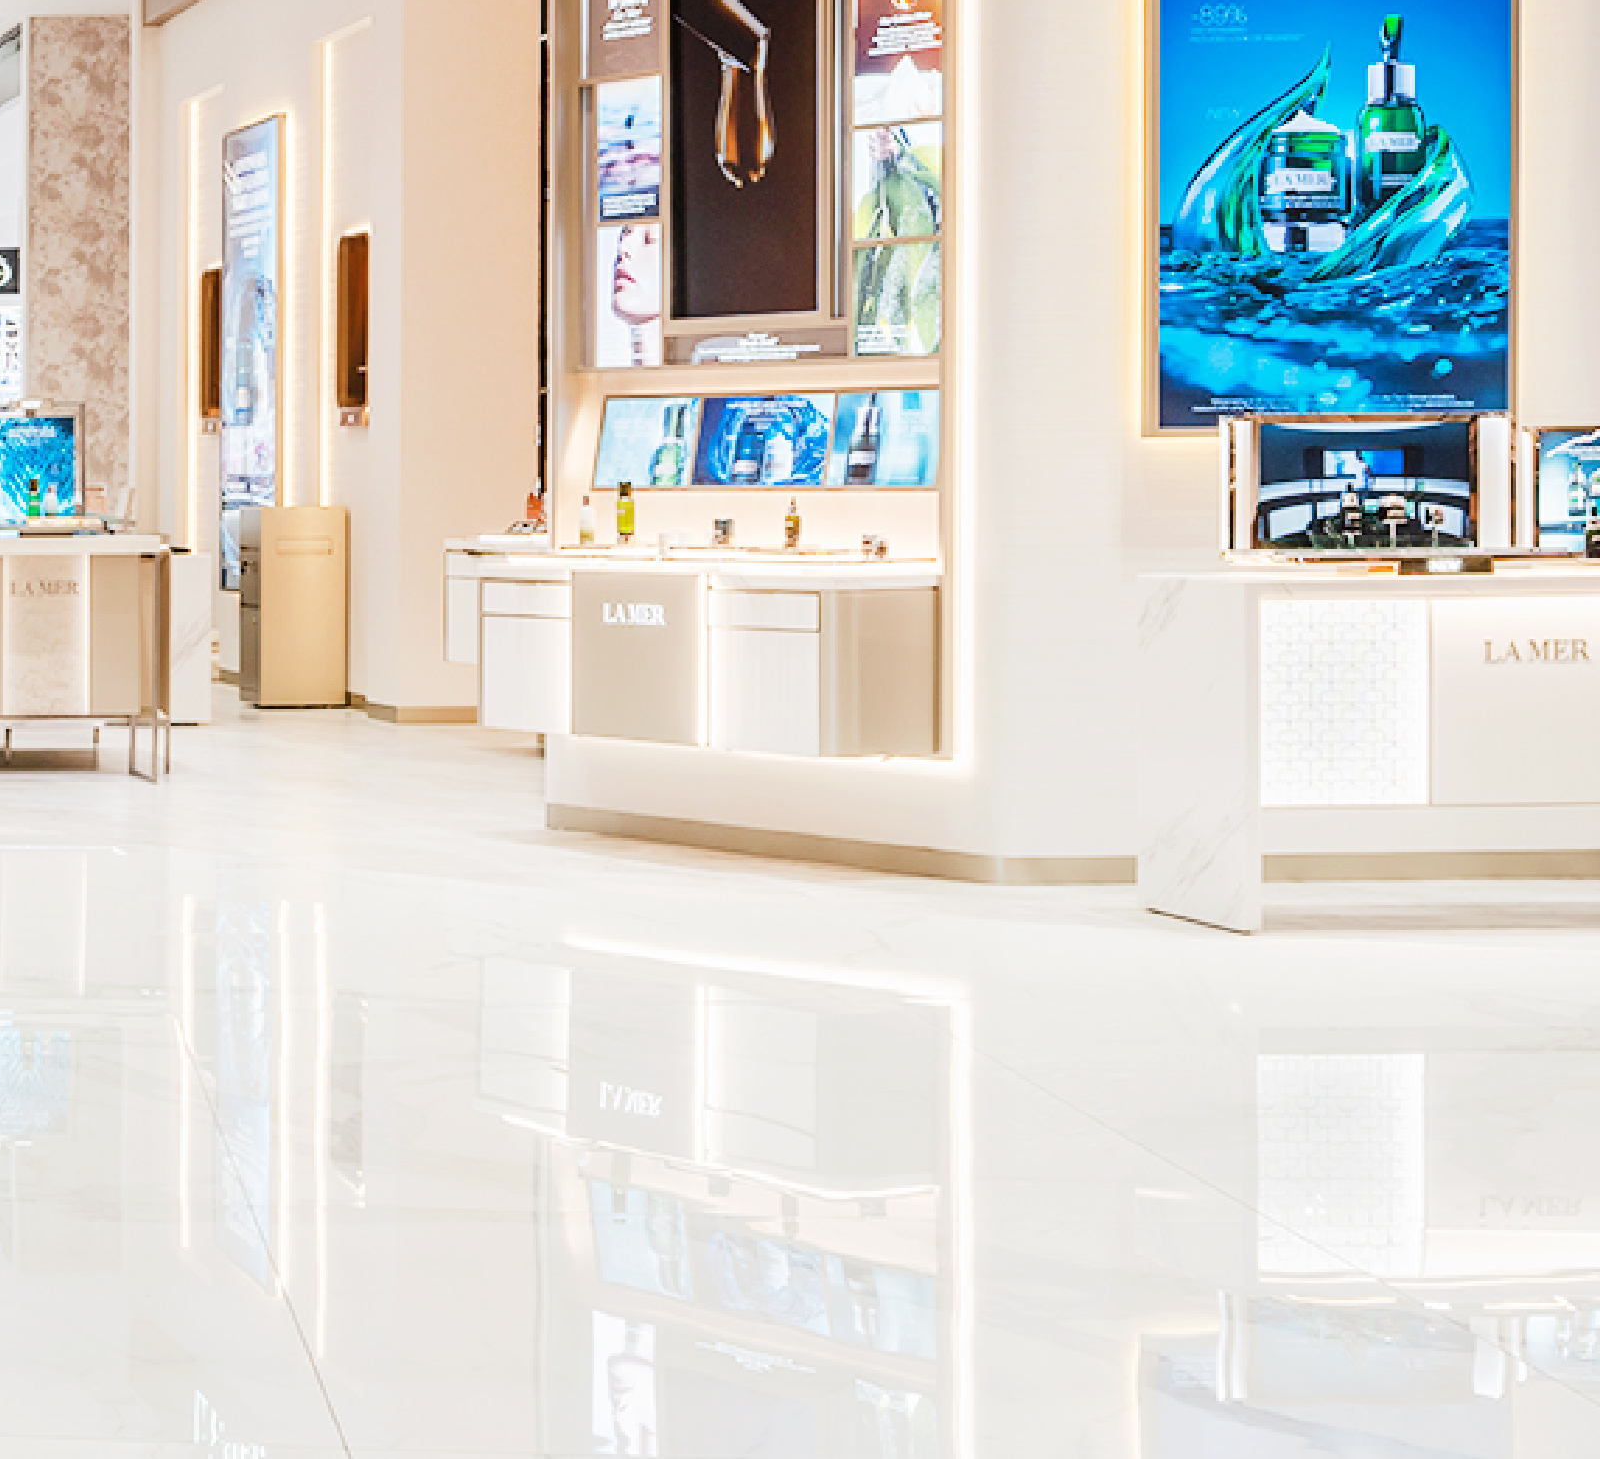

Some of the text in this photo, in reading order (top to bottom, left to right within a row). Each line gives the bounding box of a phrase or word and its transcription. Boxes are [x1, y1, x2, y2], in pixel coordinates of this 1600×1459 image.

[602, 602, 666, 626] LA MER
[1483, 637, 1591, 664] LA MER
